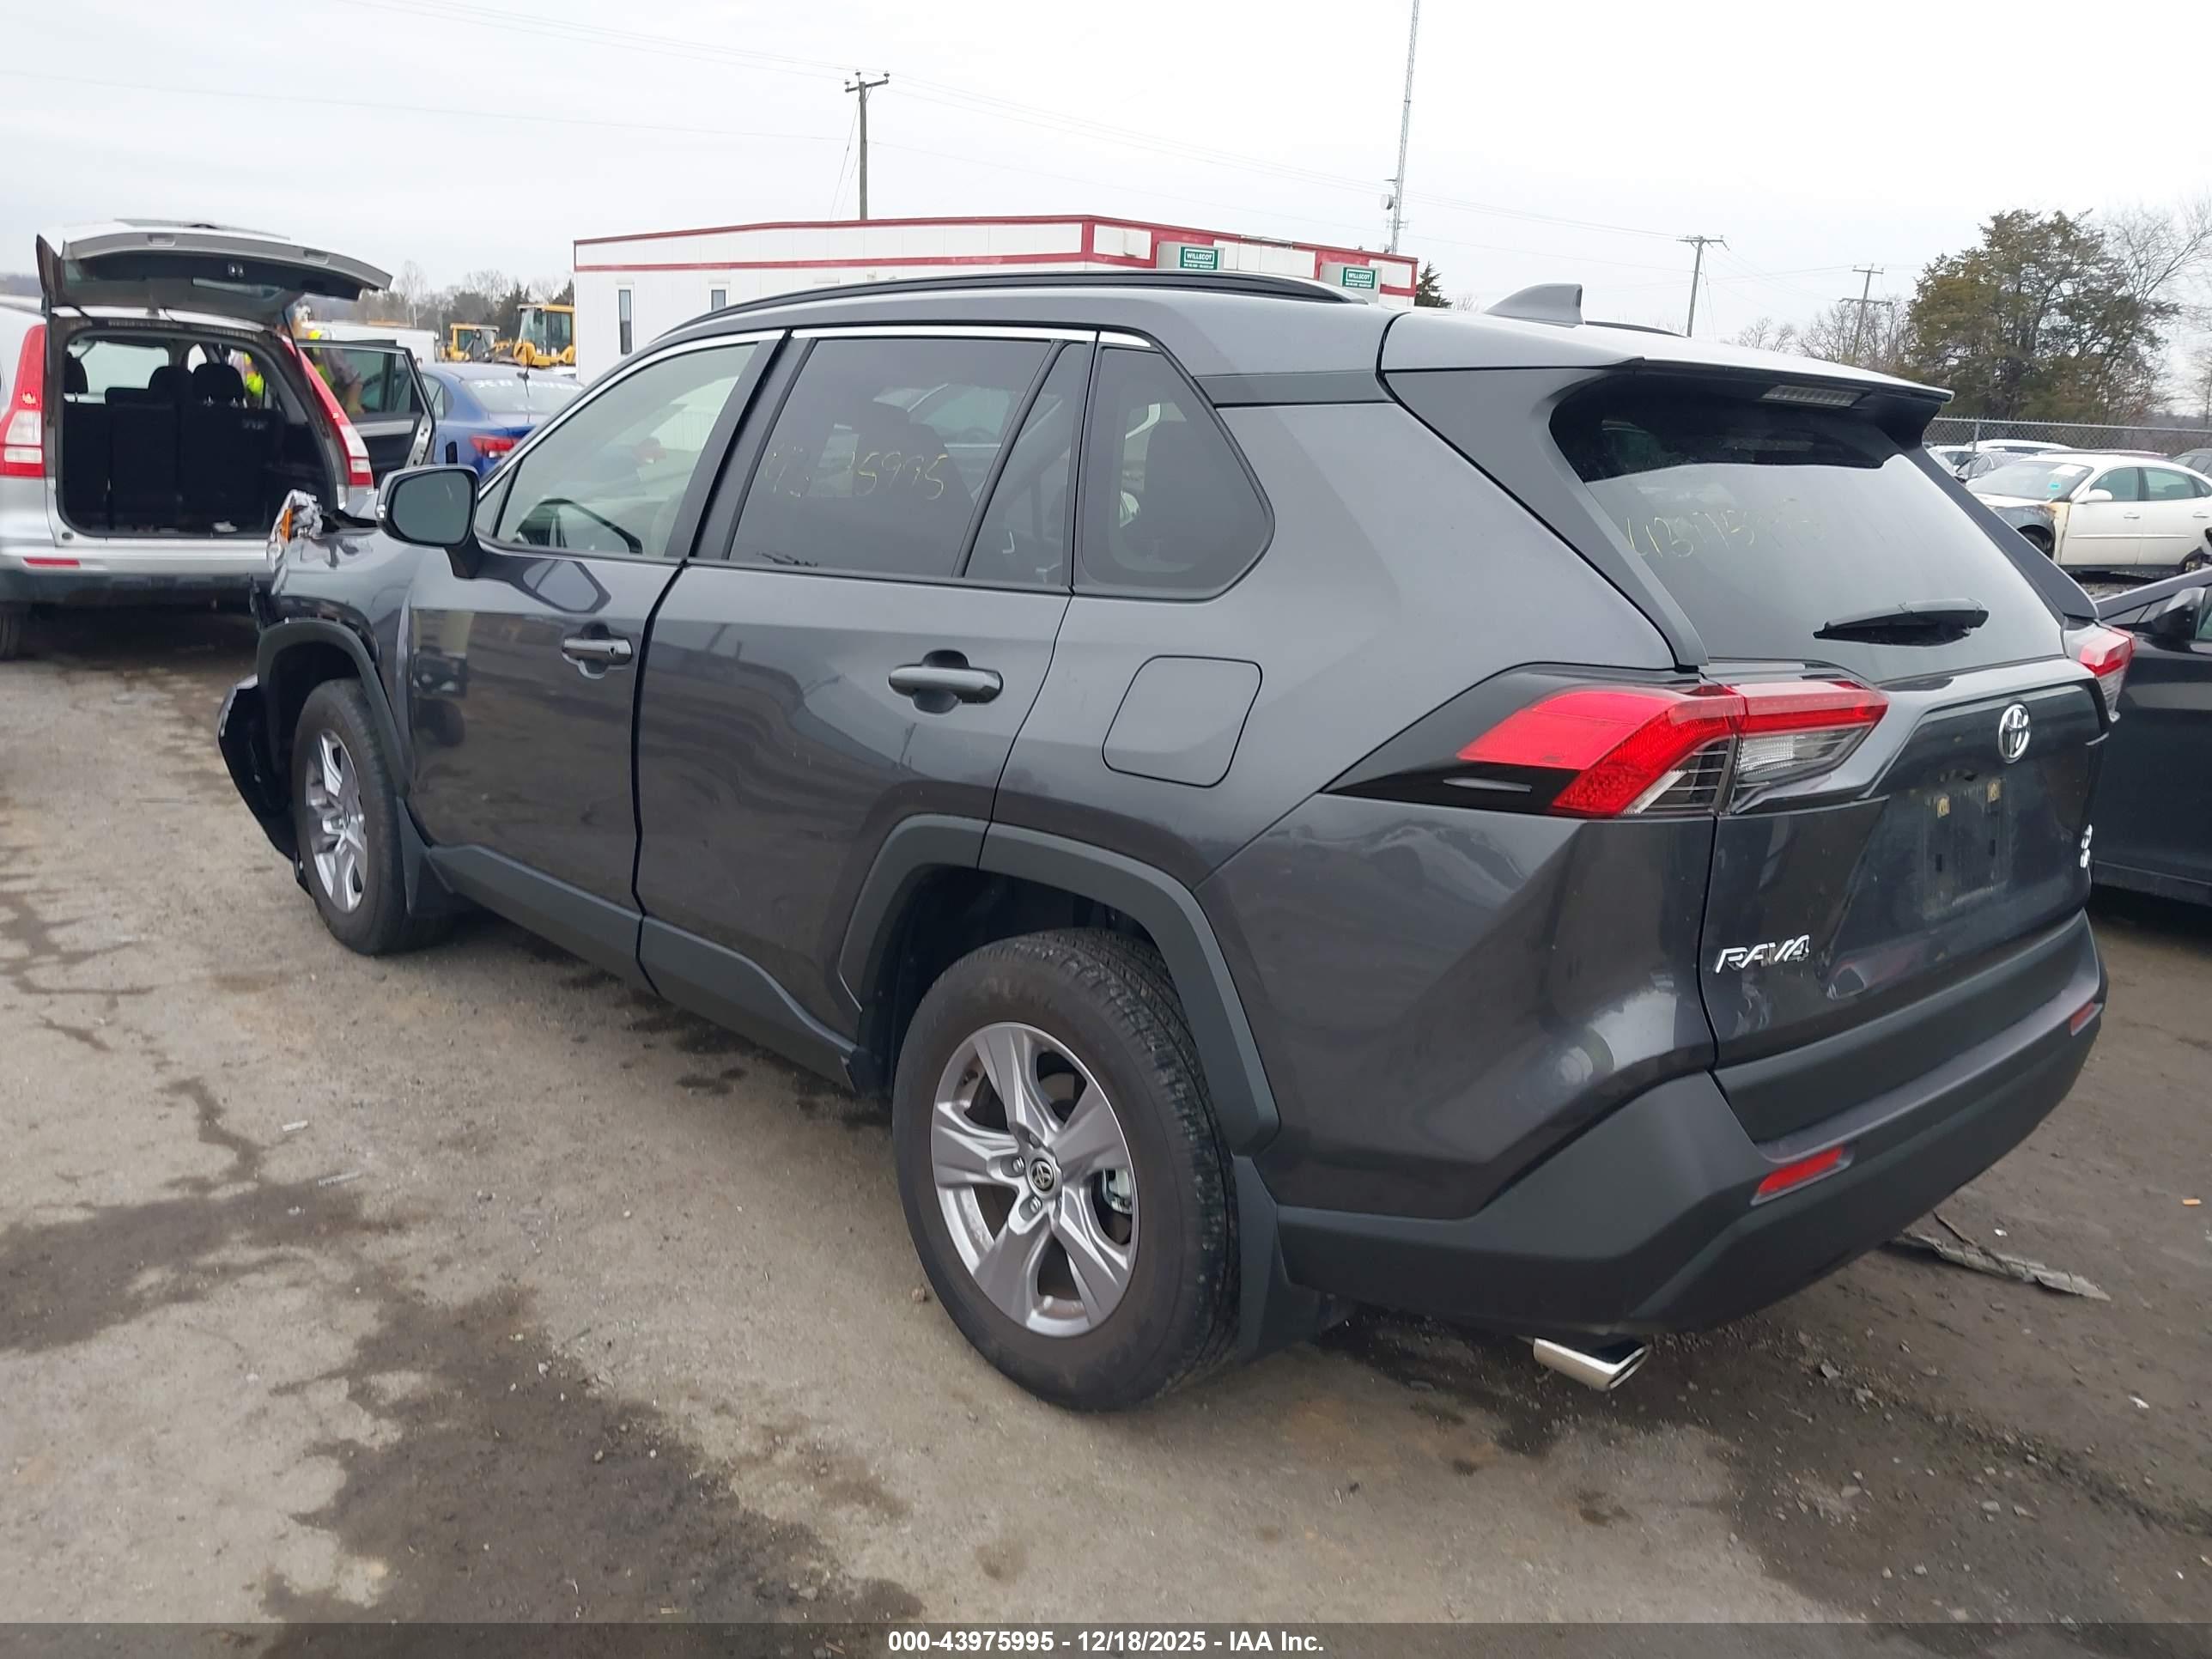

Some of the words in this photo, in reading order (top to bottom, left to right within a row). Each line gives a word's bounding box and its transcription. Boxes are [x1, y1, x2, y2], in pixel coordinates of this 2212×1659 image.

[1186, 252, 1212, 261] WILLSCOT
[1348, 272, 1370, 282] WILLSCOT
[1714, 934, 1810, 974] RAV4
